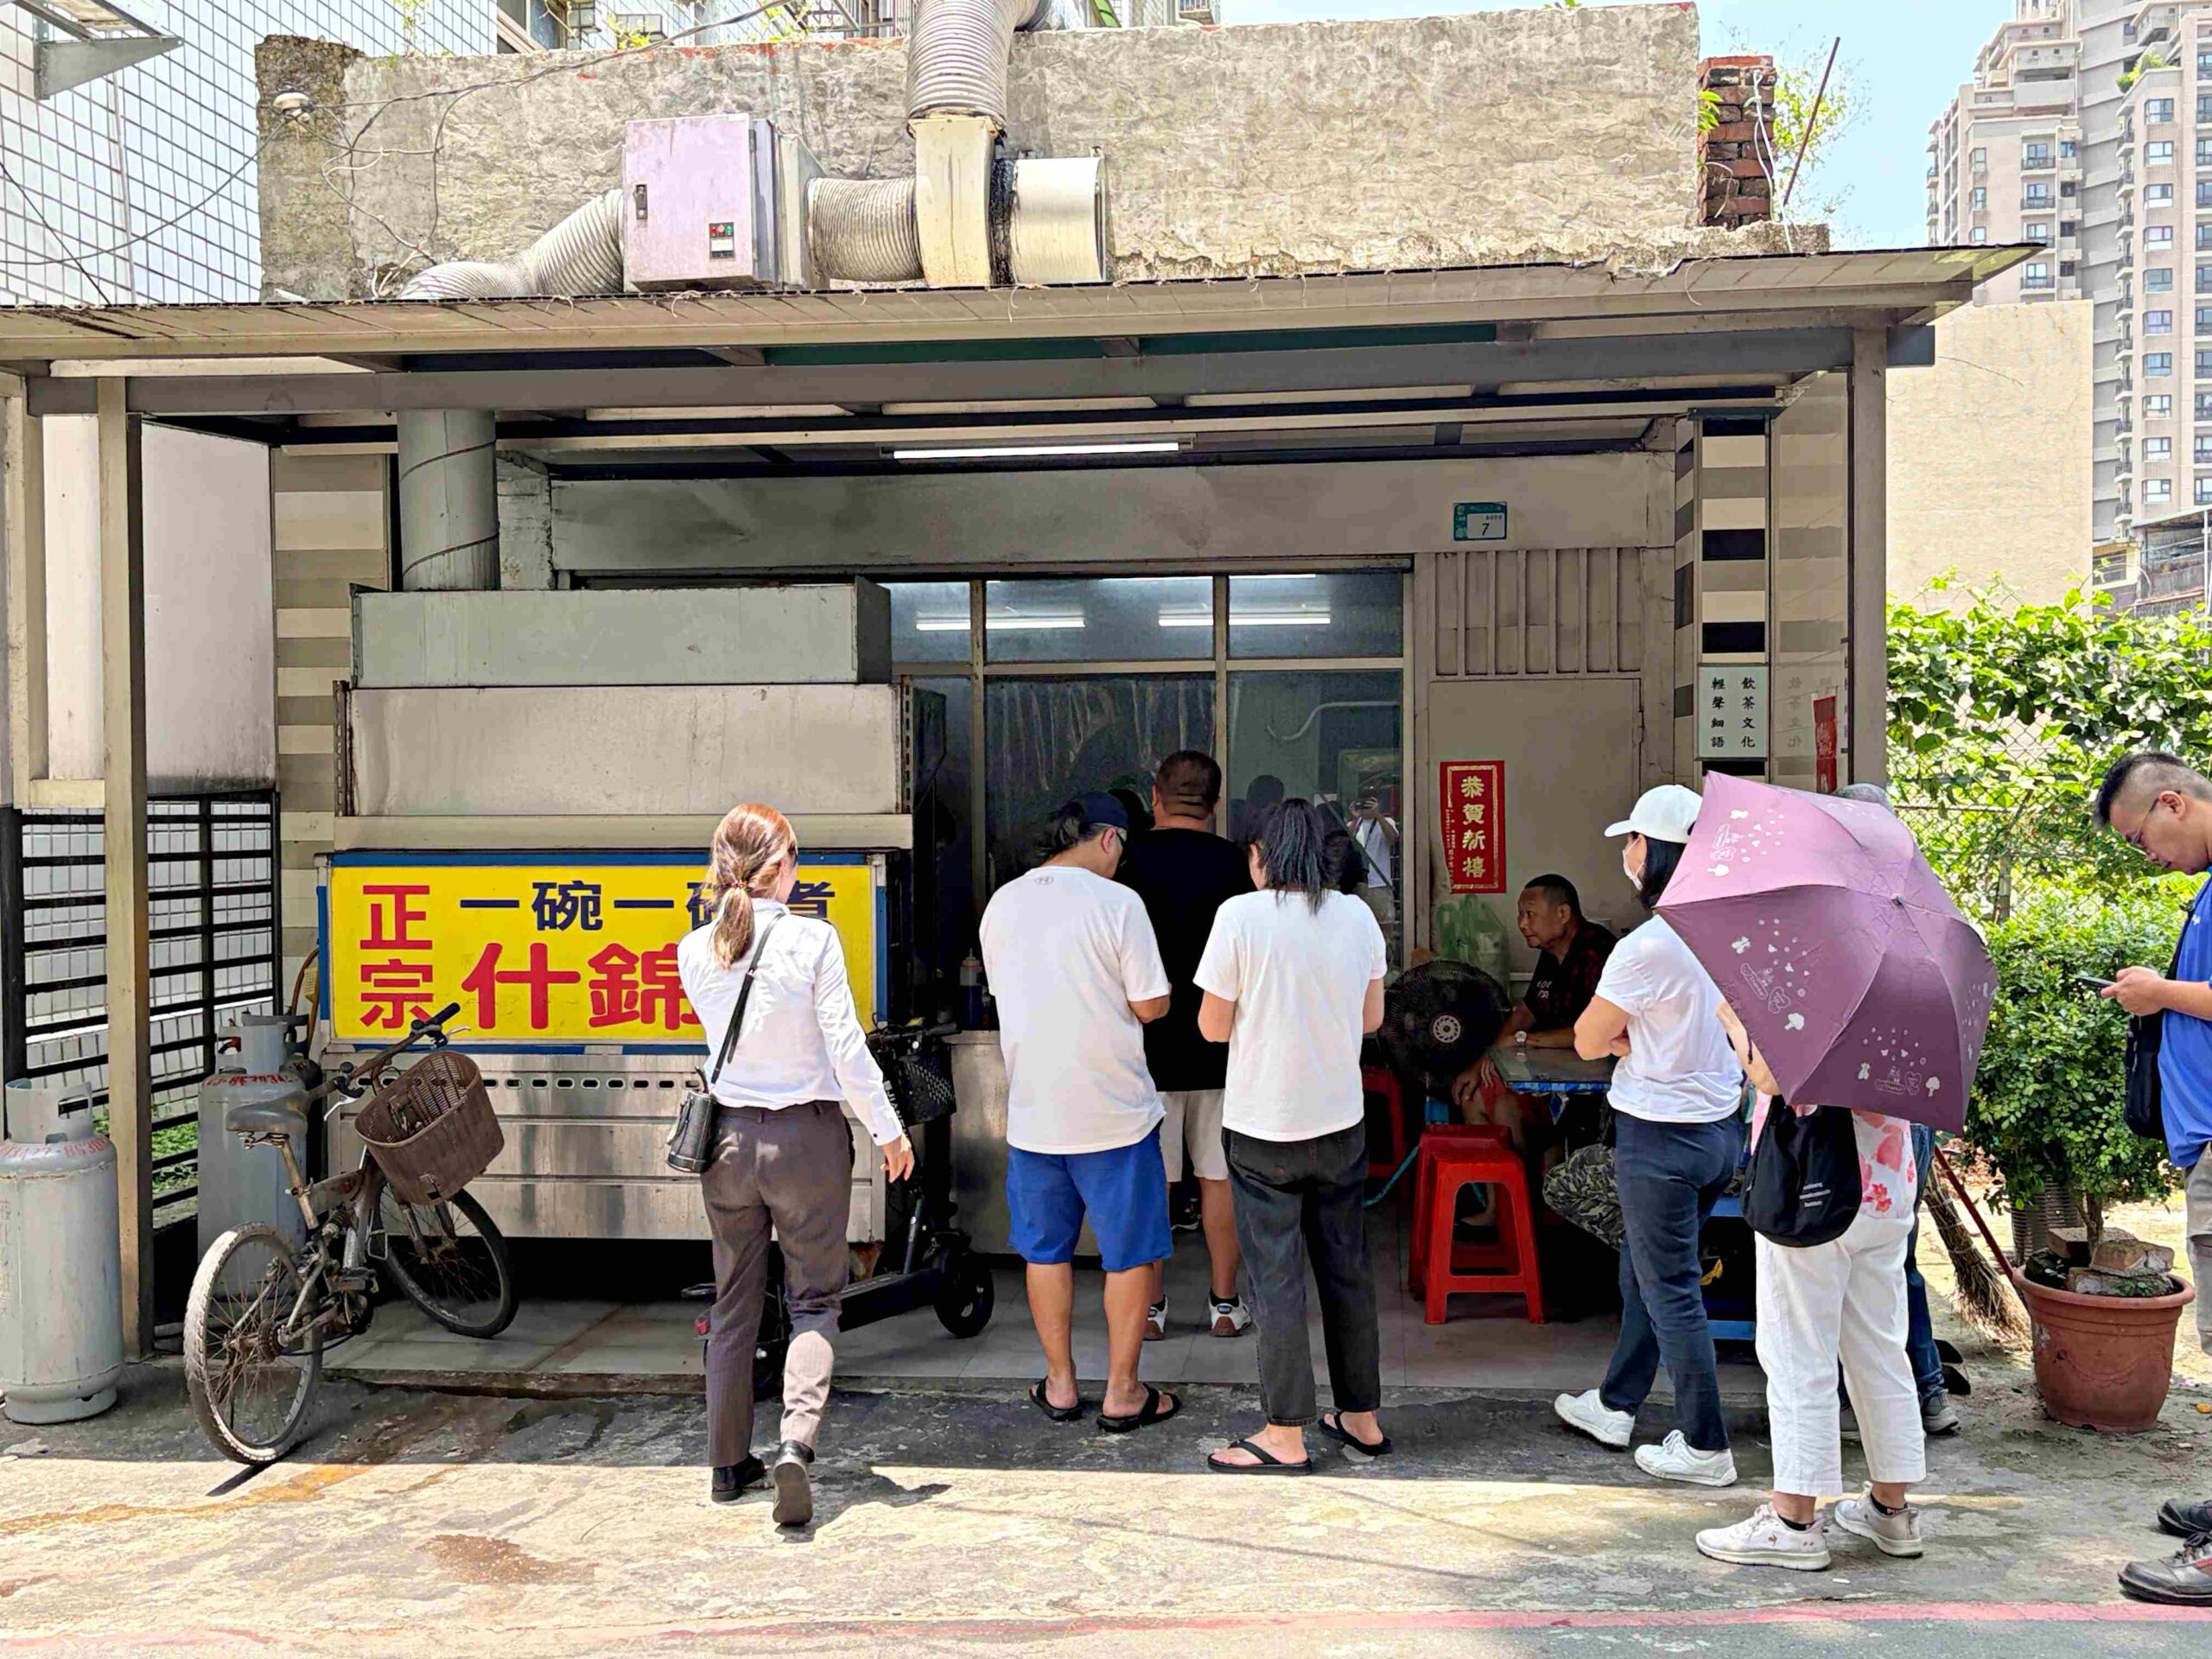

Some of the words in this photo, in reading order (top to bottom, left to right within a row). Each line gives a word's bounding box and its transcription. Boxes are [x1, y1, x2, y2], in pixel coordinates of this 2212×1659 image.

[1481, 523, 1490, 536] 7
[1710, 677, 1726, 748] 輕聲細語
[1740, 677, 1756, 748] 飲茶文化
[1460, 775, 1486, 879] 恭賀新禧
[359, 884, 433, 1029] 正宗
